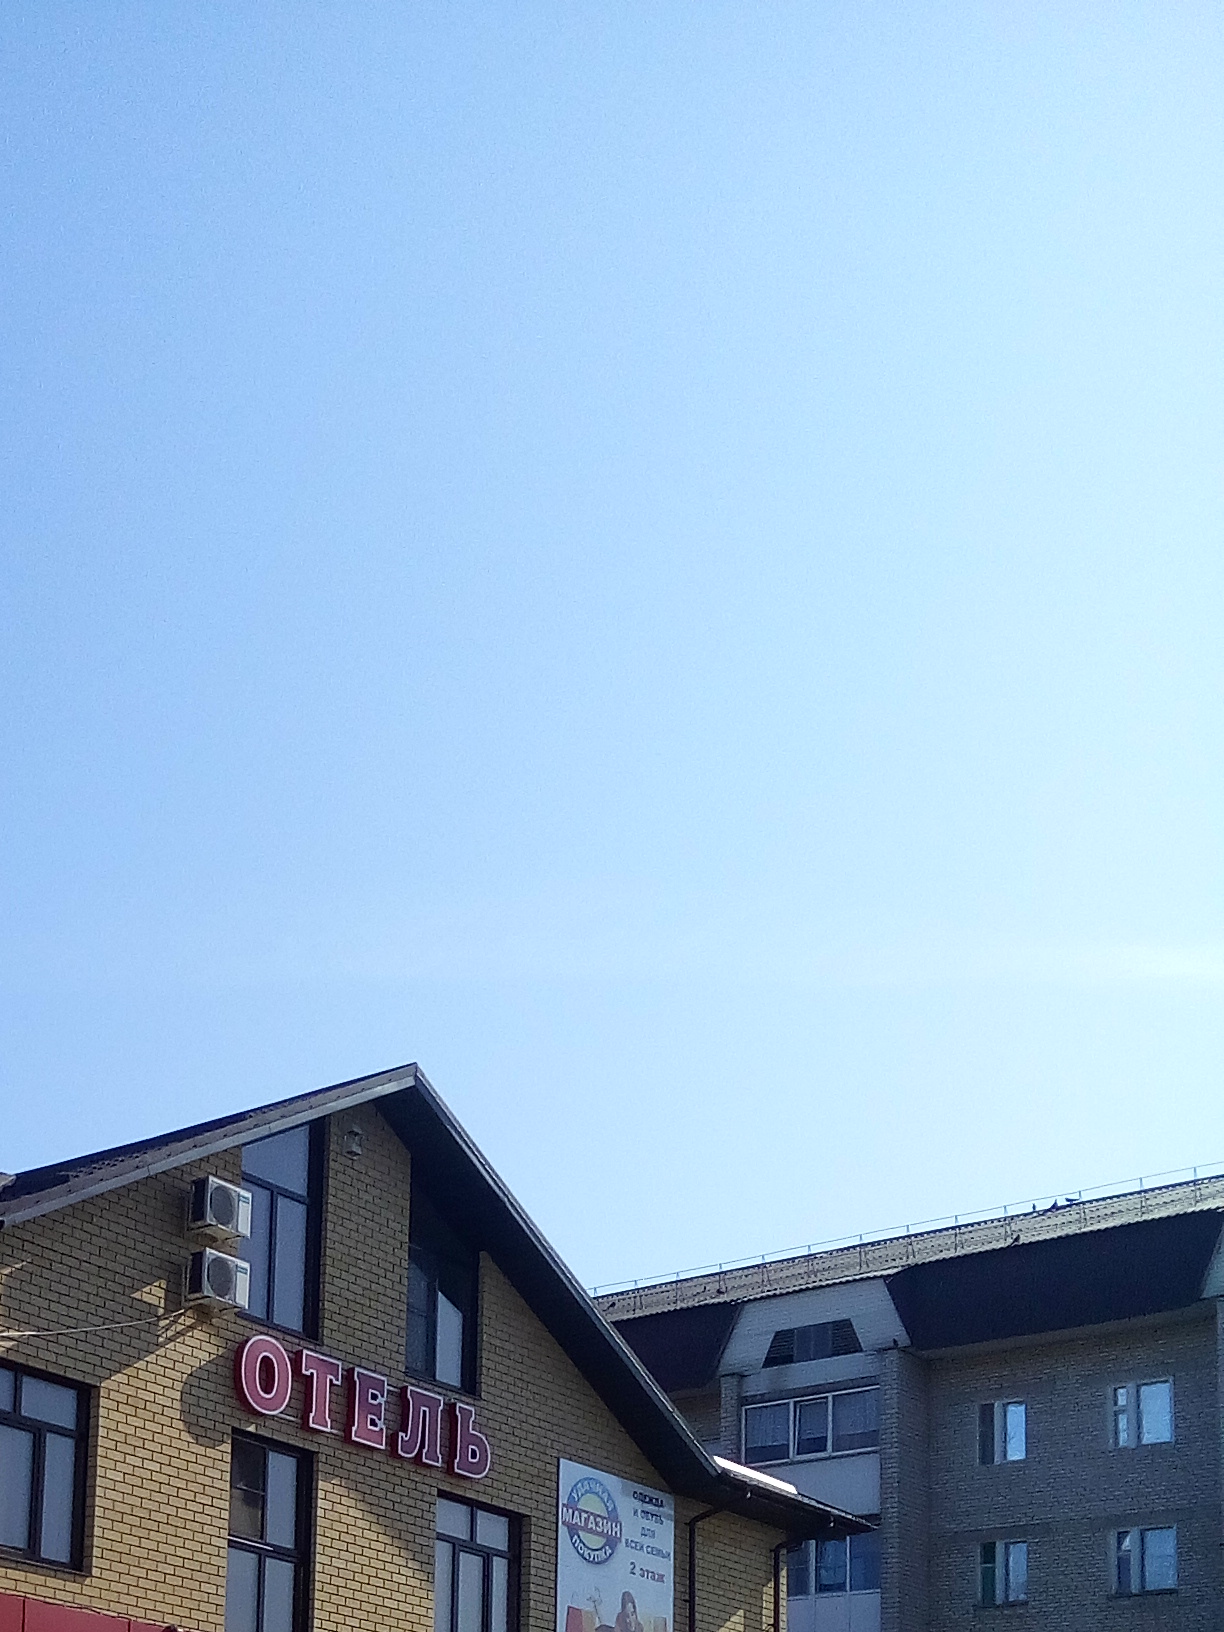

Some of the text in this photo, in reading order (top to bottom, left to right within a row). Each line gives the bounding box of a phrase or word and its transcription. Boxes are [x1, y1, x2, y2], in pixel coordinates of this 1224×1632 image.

[241, 1335, 491, 1478] ОТЕЛЬ
[562, 1507, 621, 1538] МАГАЗИН
[629, 1561, 637, 1576] 2
